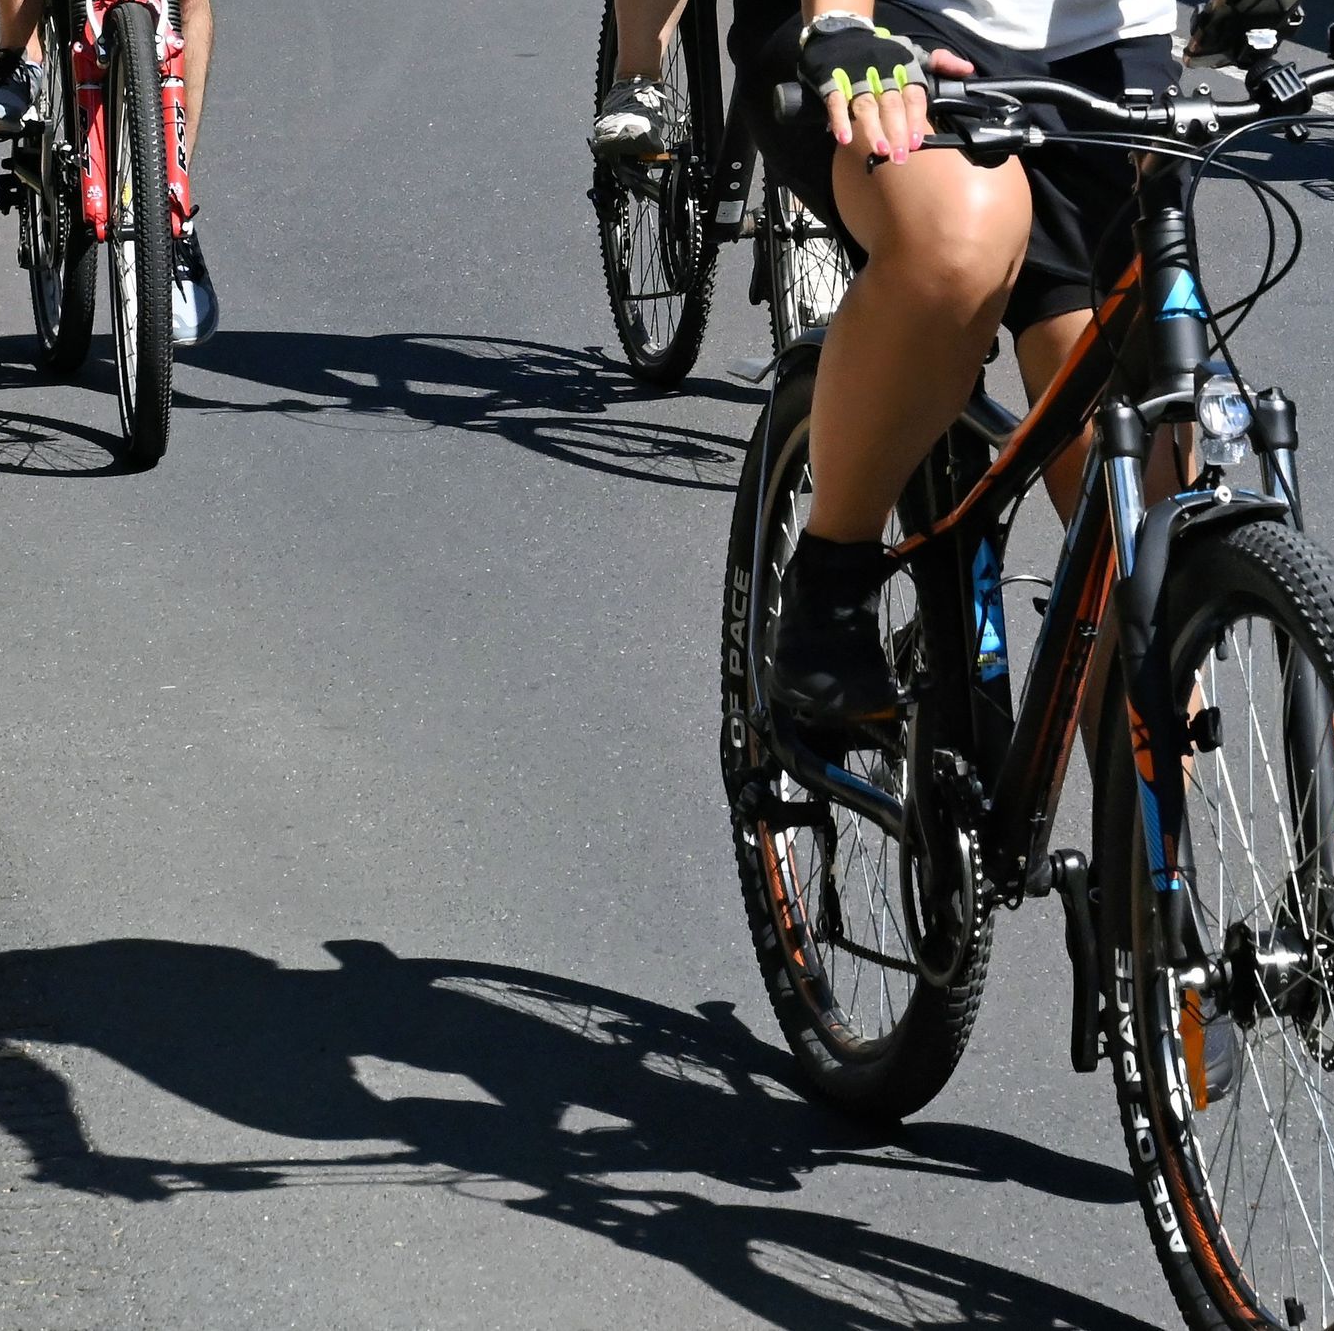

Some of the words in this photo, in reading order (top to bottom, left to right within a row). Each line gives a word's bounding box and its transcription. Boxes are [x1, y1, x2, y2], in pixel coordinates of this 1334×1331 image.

[174, 99, 188, 176] RST
[728, 565, 751, 678] PACE
[1114, 947, 1142, 1083] PACE
[1129, 1102, 1157, 1163] OF
[1147, 1174, 1189, 1253] ACE
